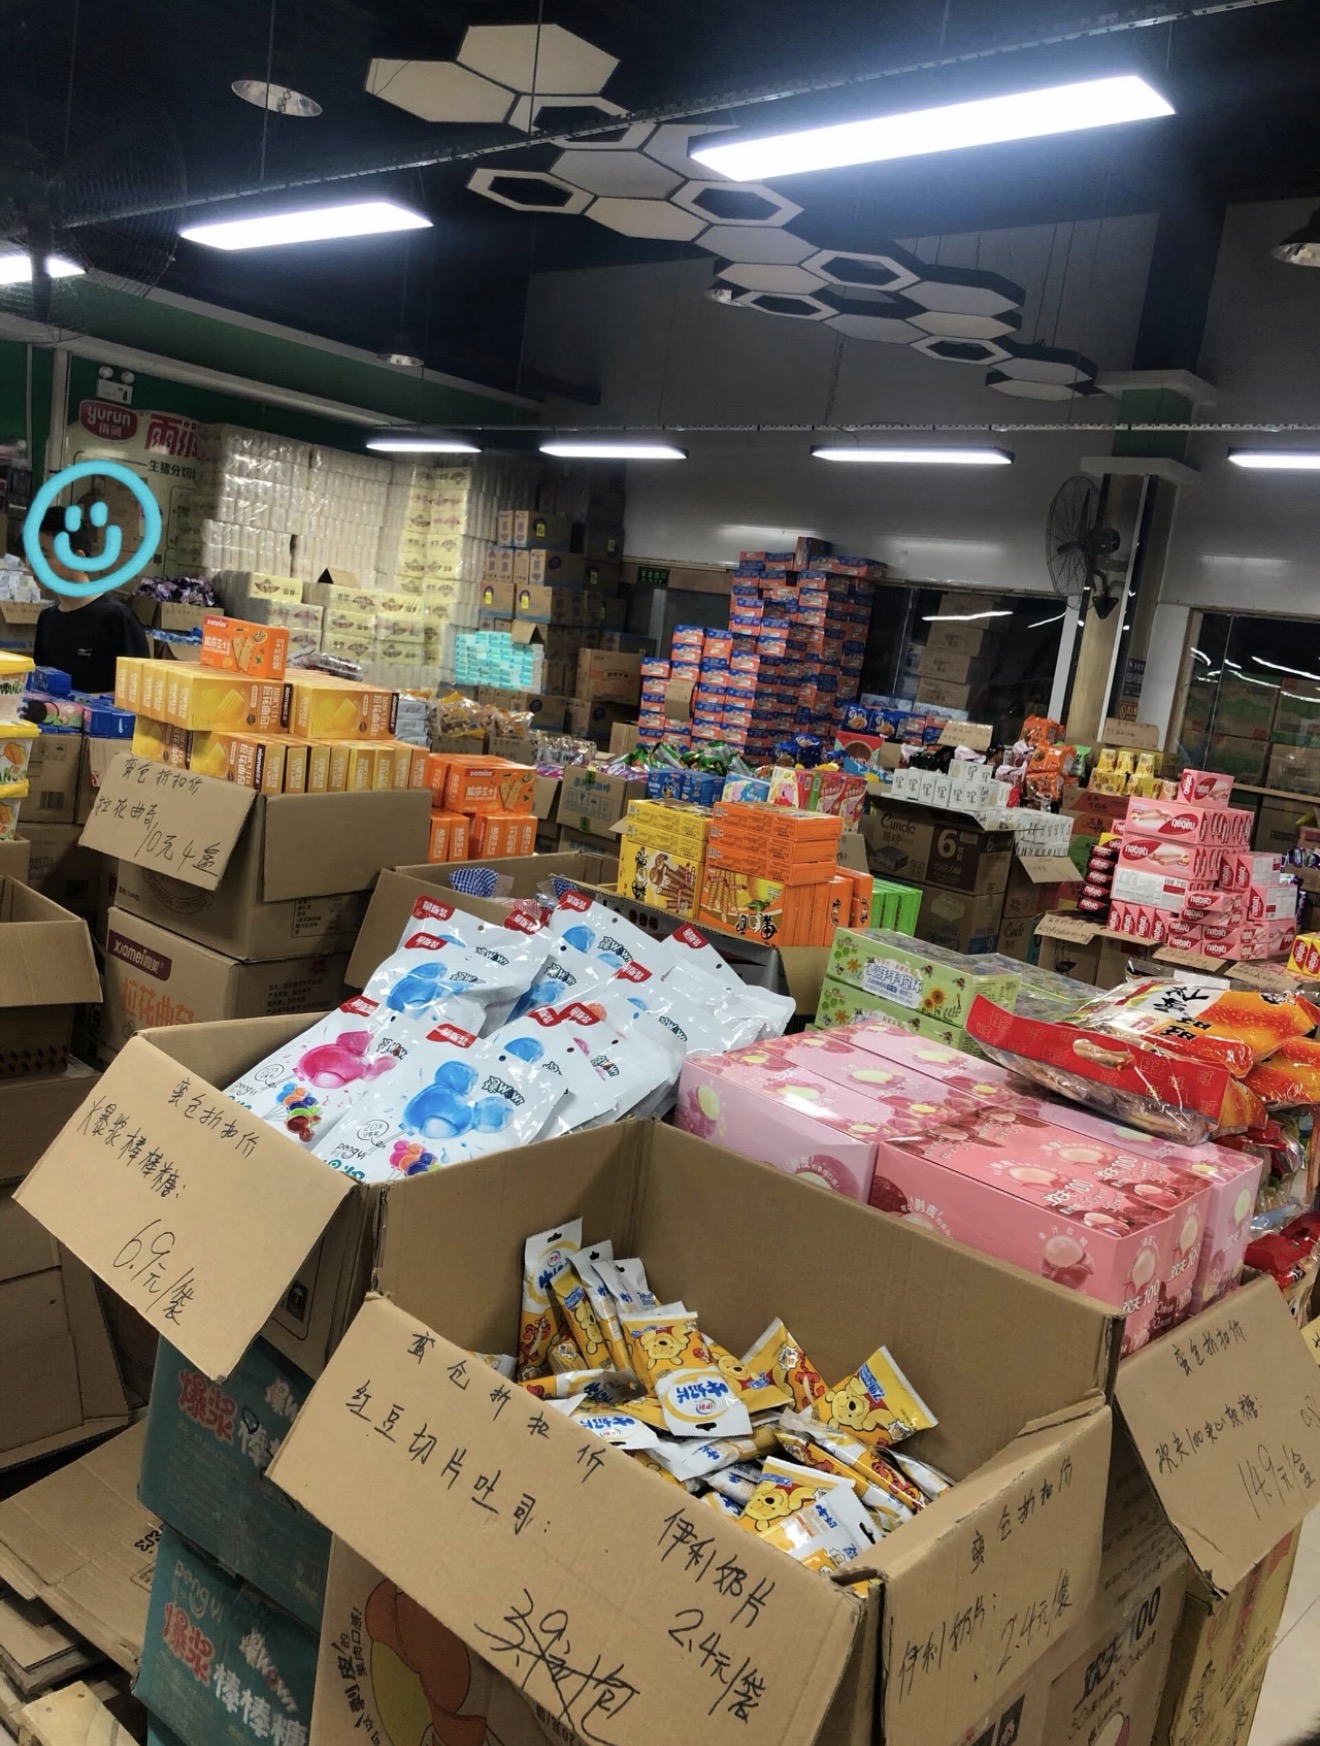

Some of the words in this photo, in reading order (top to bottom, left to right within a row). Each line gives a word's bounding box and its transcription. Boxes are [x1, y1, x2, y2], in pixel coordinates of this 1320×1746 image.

[87, 406, 131, 427] yurun
[1170, 816, 1195, 832] nabati
[937, 829, 958, 859] 6
[1124, 844, 1150, 859] nabati
[1188, 894, 1213, 907] nabati
[1169, 922, 1191, 934] nabati
[1206, 927, 1227, 938] nabati
[113, 938, 147, 962] xiamei
[1170, 937, 1193, 949] nabati
[1206, 943, 1228, 956] nabati
[1111, 1154, 1138, 1170] 100
[1064, 1178, 1094, 1194] 100
[1142, 1278, 1161, 1305] 100
[675, 1380, 730, 1405] 牛奶片
[657, 1507, 776, 1628] 伊利奶片
[1128, 1584, 1162, 1642] 100
[162, 1601, 215, 1687] 爆浆
[667, 1607, 767, 1723] 2.4元/袋
